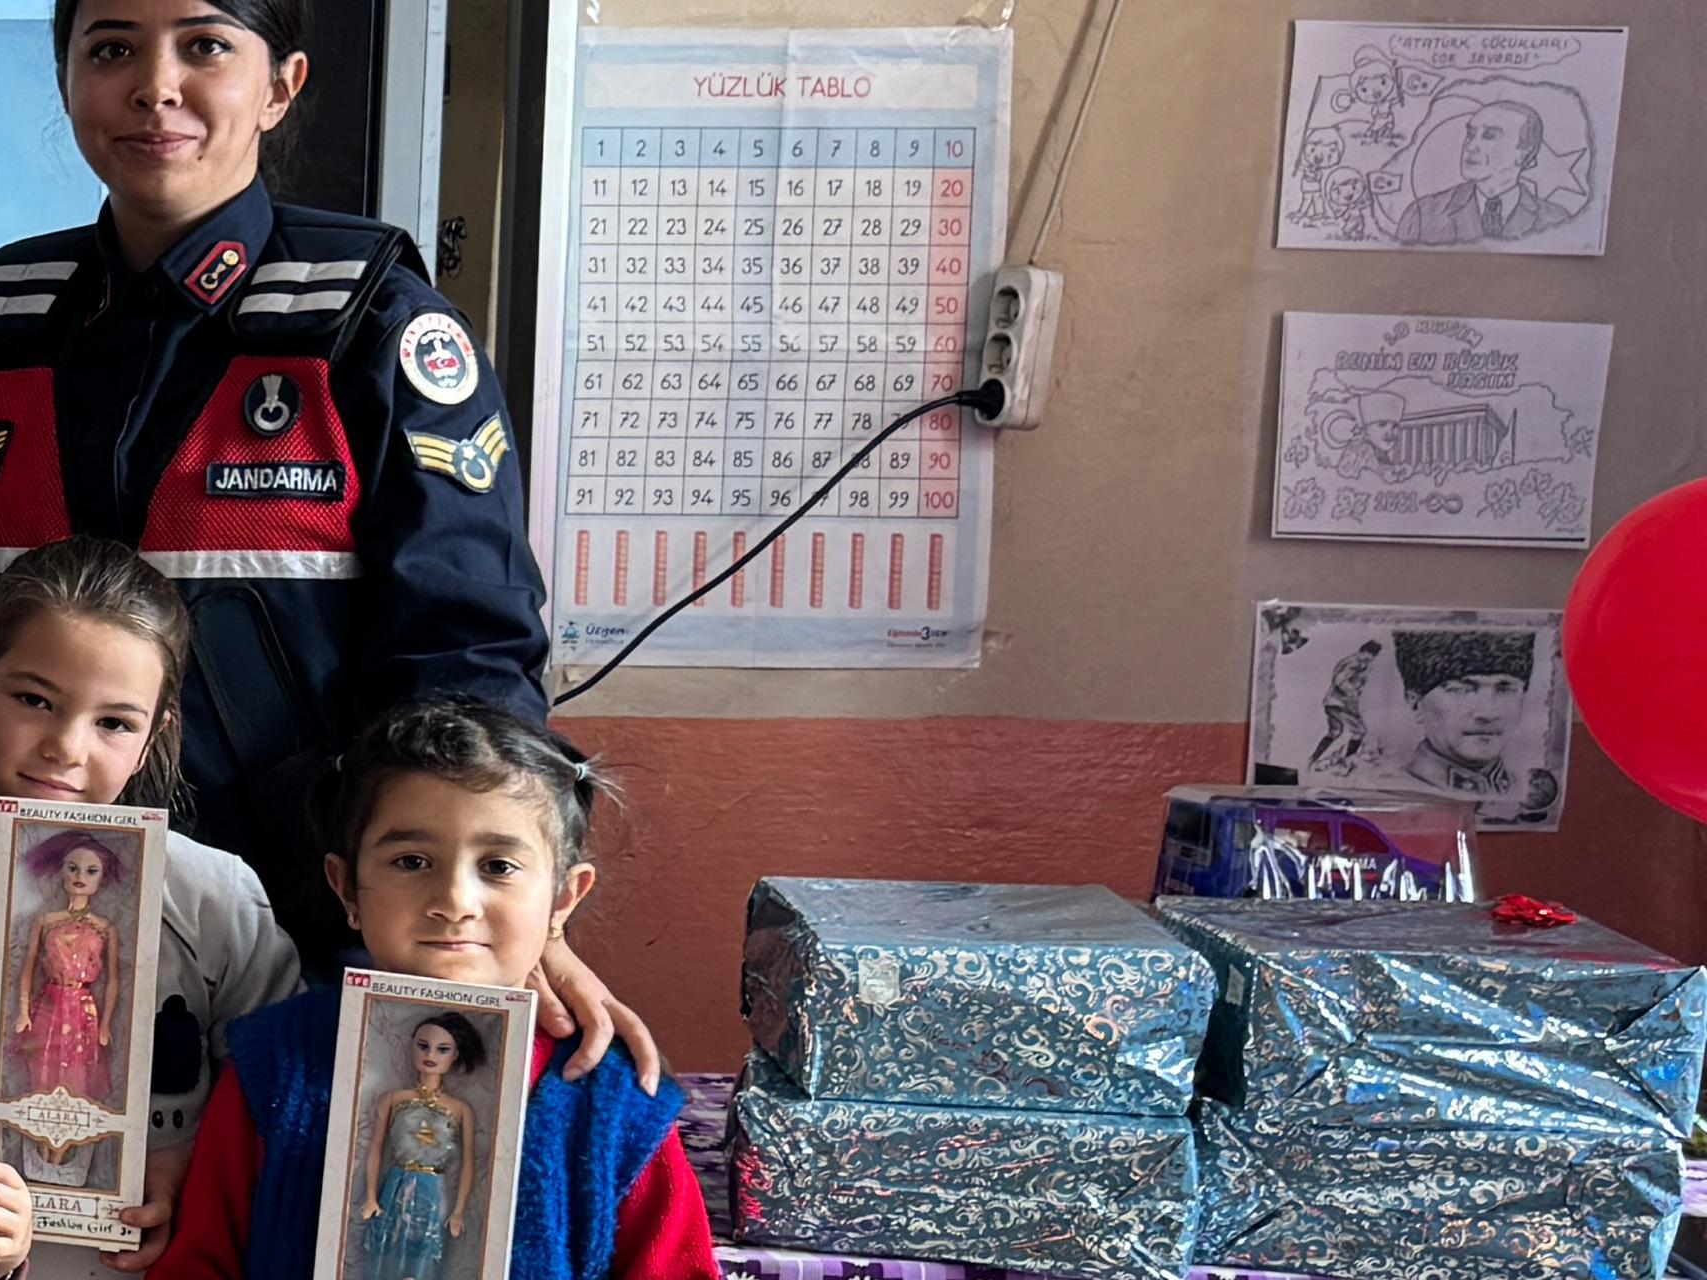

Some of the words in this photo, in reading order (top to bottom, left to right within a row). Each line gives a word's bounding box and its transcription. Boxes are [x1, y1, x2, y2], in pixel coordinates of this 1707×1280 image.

[693, 72, 787, 98] YÜZLÜK
[797, 76, 873, 98] TABLO
[597, 139, 604, 158] 1
[635, 139, 647, 158] 2
[674, 139, 686, 158] 3
[712, 140, 726, 157] 4
[753, 138, 764, 158] 5
[791, 140, 804, 158] 6
[831, 139, 842, 158] 7
[869, 139, 881, 158] 8
[908, 139, 920, 158] 9
[945, 139, 964, 159] 10
[587, 256, 606, 274] 31
[626, 256, 648, 275] 32
[664, 256, 687, 275] 33
[701, 256, 725, 275] 34
[741, 256, 764, 276] 35
[780, 257, 803, 276] 36
[820, 257, 842, 276] 37
[858, 257, 881, 276] 38
[897, 257, 920, 276] 39
[935, 257, 962, 276] 40
[1407, 351, 1437, 371] EN
[215, 465, 337, 492] JANDARMA
[19, 807, 59, 821] BEAUTY
[62, 810, 113, 825] FASHION
[115, 815, 139, 827] GIRL
[372, 981, 417, 997] BEAUTY
[419, 987, 473, 1004] FASHION
[475, 993, 502, 1008] GIRL
[34, 1197, 83, 1212] LARA
